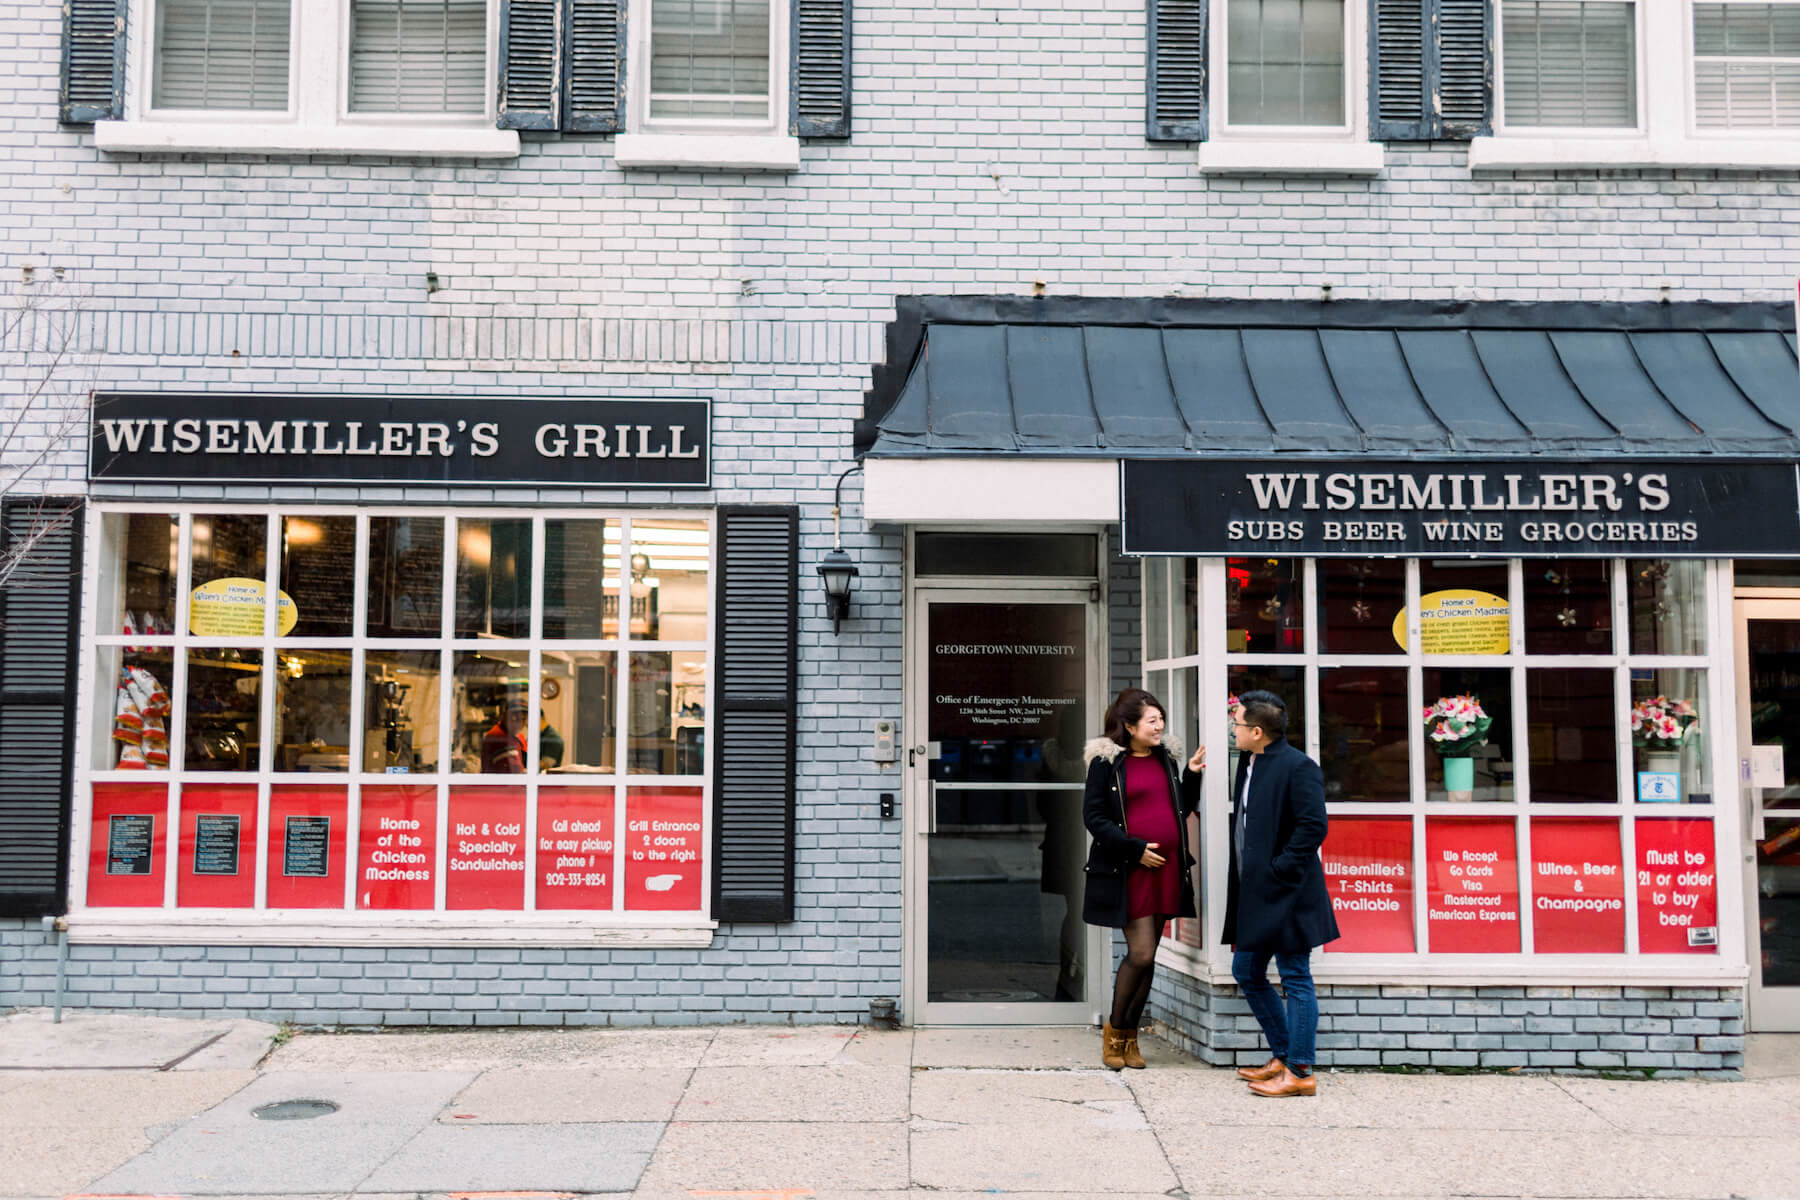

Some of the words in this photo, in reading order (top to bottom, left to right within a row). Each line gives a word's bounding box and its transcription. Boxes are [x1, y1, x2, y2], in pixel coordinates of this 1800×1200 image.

[99, 419, 500, 457] WISEMILLER'S
[535, 423, 700, 460] GRILL
[1246, 473, 1670, 511] WISEMILLER'S
[1228, 521, 1304, 541] SUBS
[1323, 521, 1407, 541] BEER
[1422, 521, 1503, 542] WINE
[1520, 522, 1698, 542] GROCERIES
[1442, 599, 1464, 607] Home
[1437, 608, 1472, 618] Chicken
[936, 644, 1013, 655] GEORGETOWN
[1015, 645, 1076, 655] UNIVERSITY
[936, 695, 961, 704] Office
[963, 695, 973, 704] of
[974, 695, 1019, 707] Emergency
[1022, 696, 1076, 707] Management
[380, 817, 420, 830] Home
[456, 823, 476, 835] Hot
[481, 823, 490, 835] &
[495, 823, 520, 836] Cold
[552, 820, 568, 832] Call
[571, 820, 601, 832] ahead
[629, 820, 648, 831] Grill
[652, 820, 700, 832] Entrance
[377, 834, 393, 846] of
[398, 834, 421, 846] the
[540, 837, 553, 850] for
[556, 840, 578, 853] easy
[581, 838, 612, 853] pickup
[643, 835, 650, 846] 2
[654, 835, 685, 846] doors
[459, 841, 516, 855] Specialty
[371, 851, 426, 863] Chicken
[556, 855, 585, 869] phone
[589, 855, 595, 867] #
[633, 850, 644, 860] to
[648, 850, 666, 860] the
[670, 850, 696, 862] right
[1443, 850, 1459, 861] We
[1462, 850, 1498, 864] Accept
[1646, 850, 1678, 865] Must
[1684, 850, 1706, 865] be
[450, 858, 524, 871] Sandwiches
[1324, 862, 1405, 876] Wisemiller's
[1449, 865, 1463, 876] Go
[1466, 865, 1493, 876] Cards
[1583, 863, 1616, 875] Beer
[366, 867, 430, 880] Madness
[1638, 871, 1650, 886] 21
[1656, 873, 1671, 886] or
[1677, 871, 1714, 886] older
[1339, 880, 1393, 893] T-Shirts
[1462, 879, 1482, 891] Visa
[1573, 879, 1584, 893] &
[1333, 897, 1400, 911] Available
[1444, 894, 1501, 906] Mastercard
[1536, 897, 1622, 912] Champagne
[1652, 891, 1666, 905] to
[1673, 891, 1699, 909] buy
[1429, 909, 1476, 920] American
[1479, 909, 1516, 923] Express
[1659, 911, 1693, 926] beer
